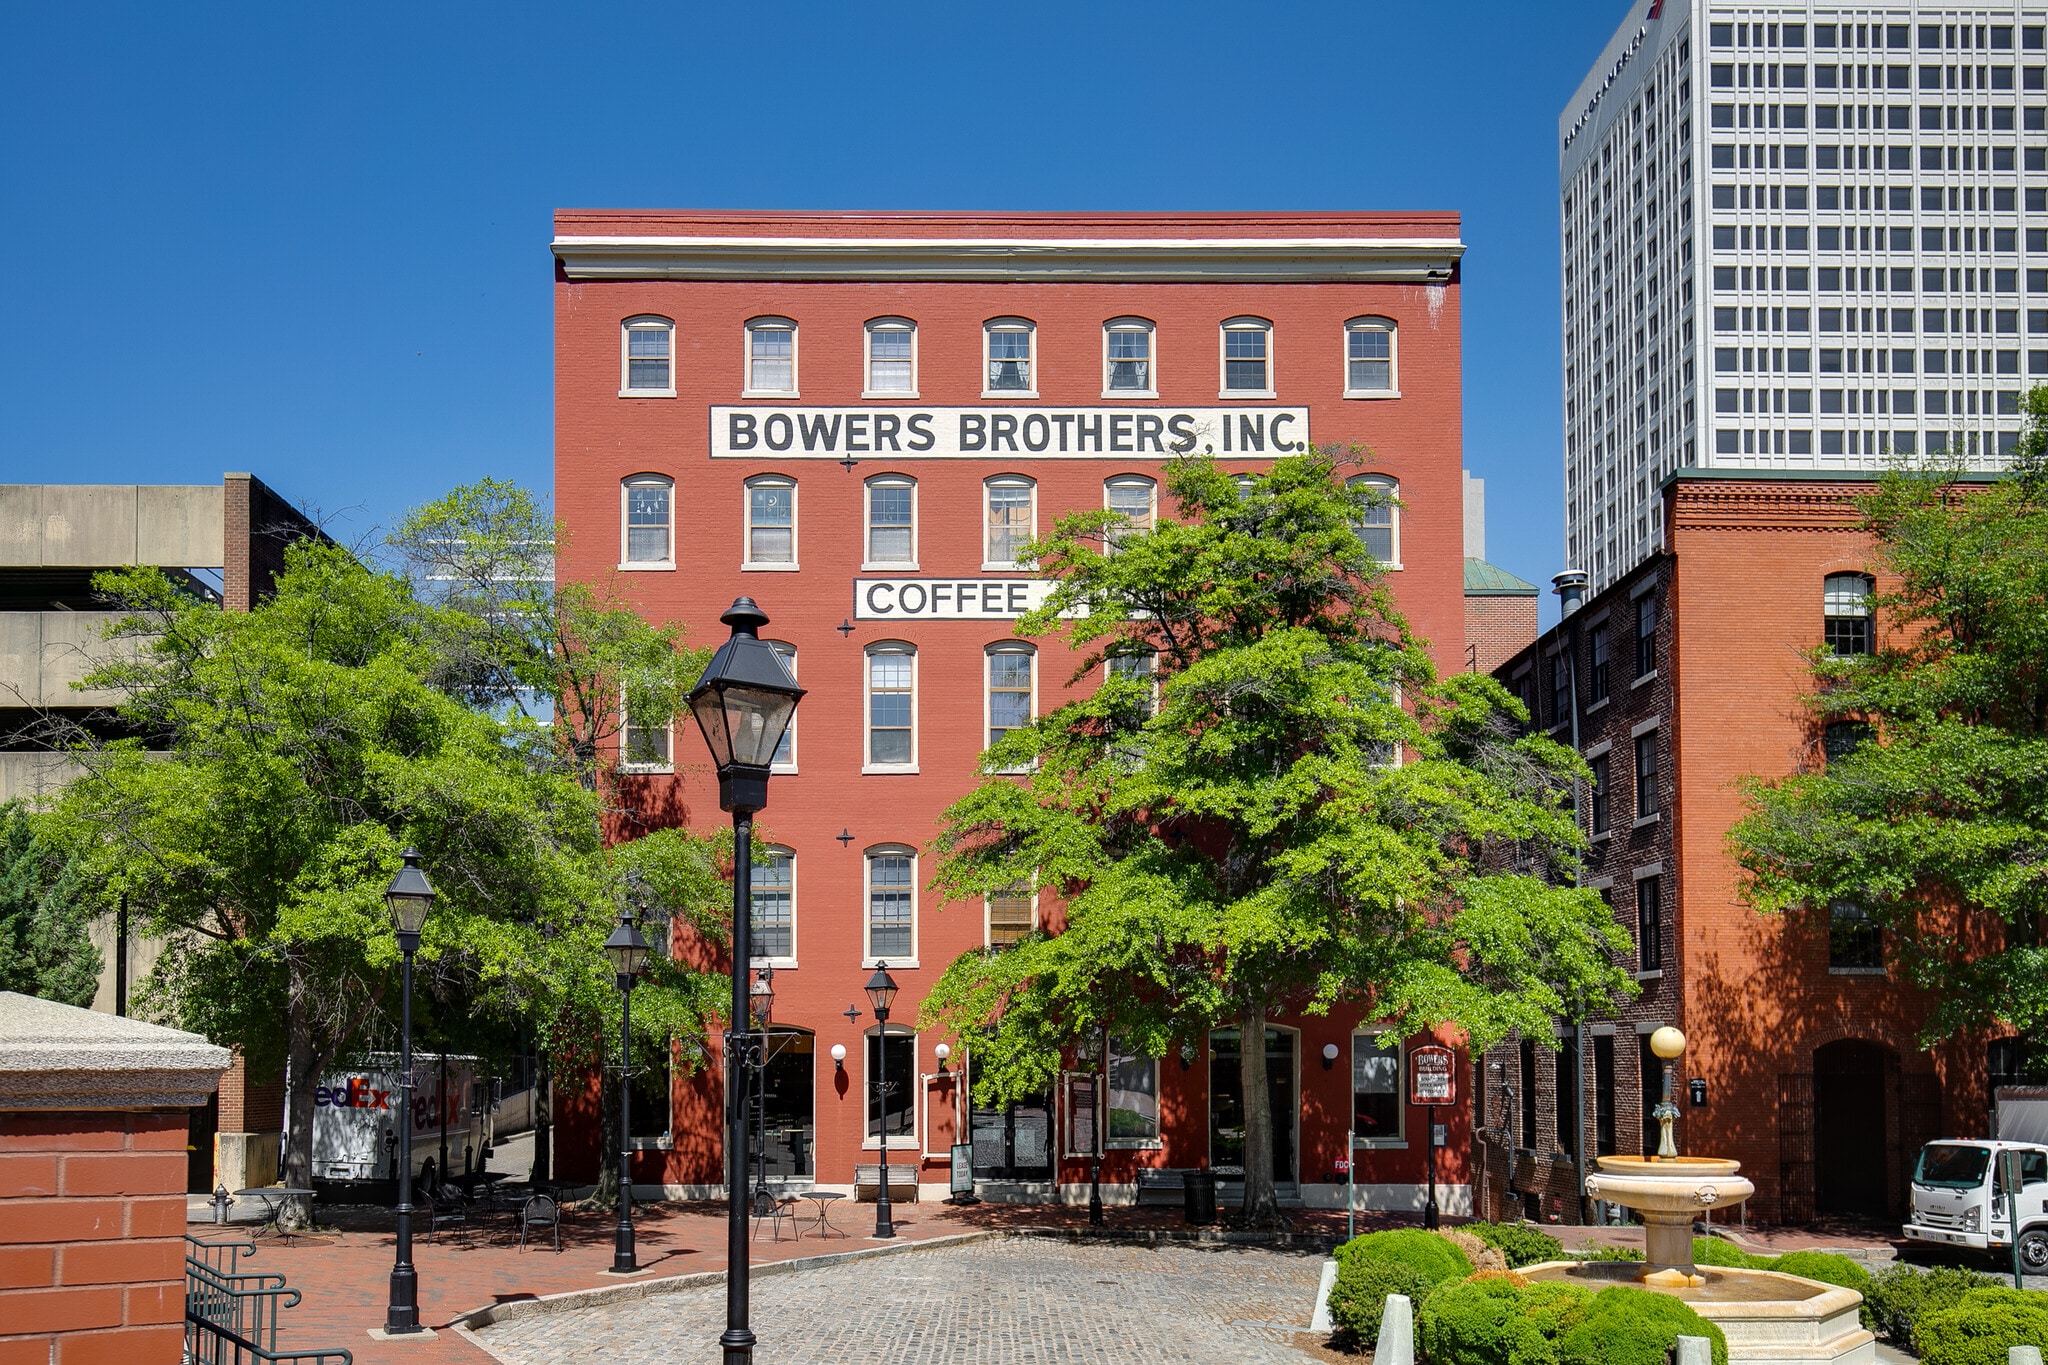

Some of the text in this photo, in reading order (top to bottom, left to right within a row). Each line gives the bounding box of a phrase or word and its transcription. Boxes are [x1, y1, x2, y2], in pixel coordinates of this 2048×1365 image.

[1564, 26, 1646, 150] BANK OF AMERICA
[728, 413, 1306, 454] BOWERS BROTHERS, INC.
[866, 583, 1029, 613] COFFEE
[1418, 1054, 1449, 1065] BOWERS
[315, 1078, 391, 1110] edEx
[1335, 1160, 1349, 1169] FDC
